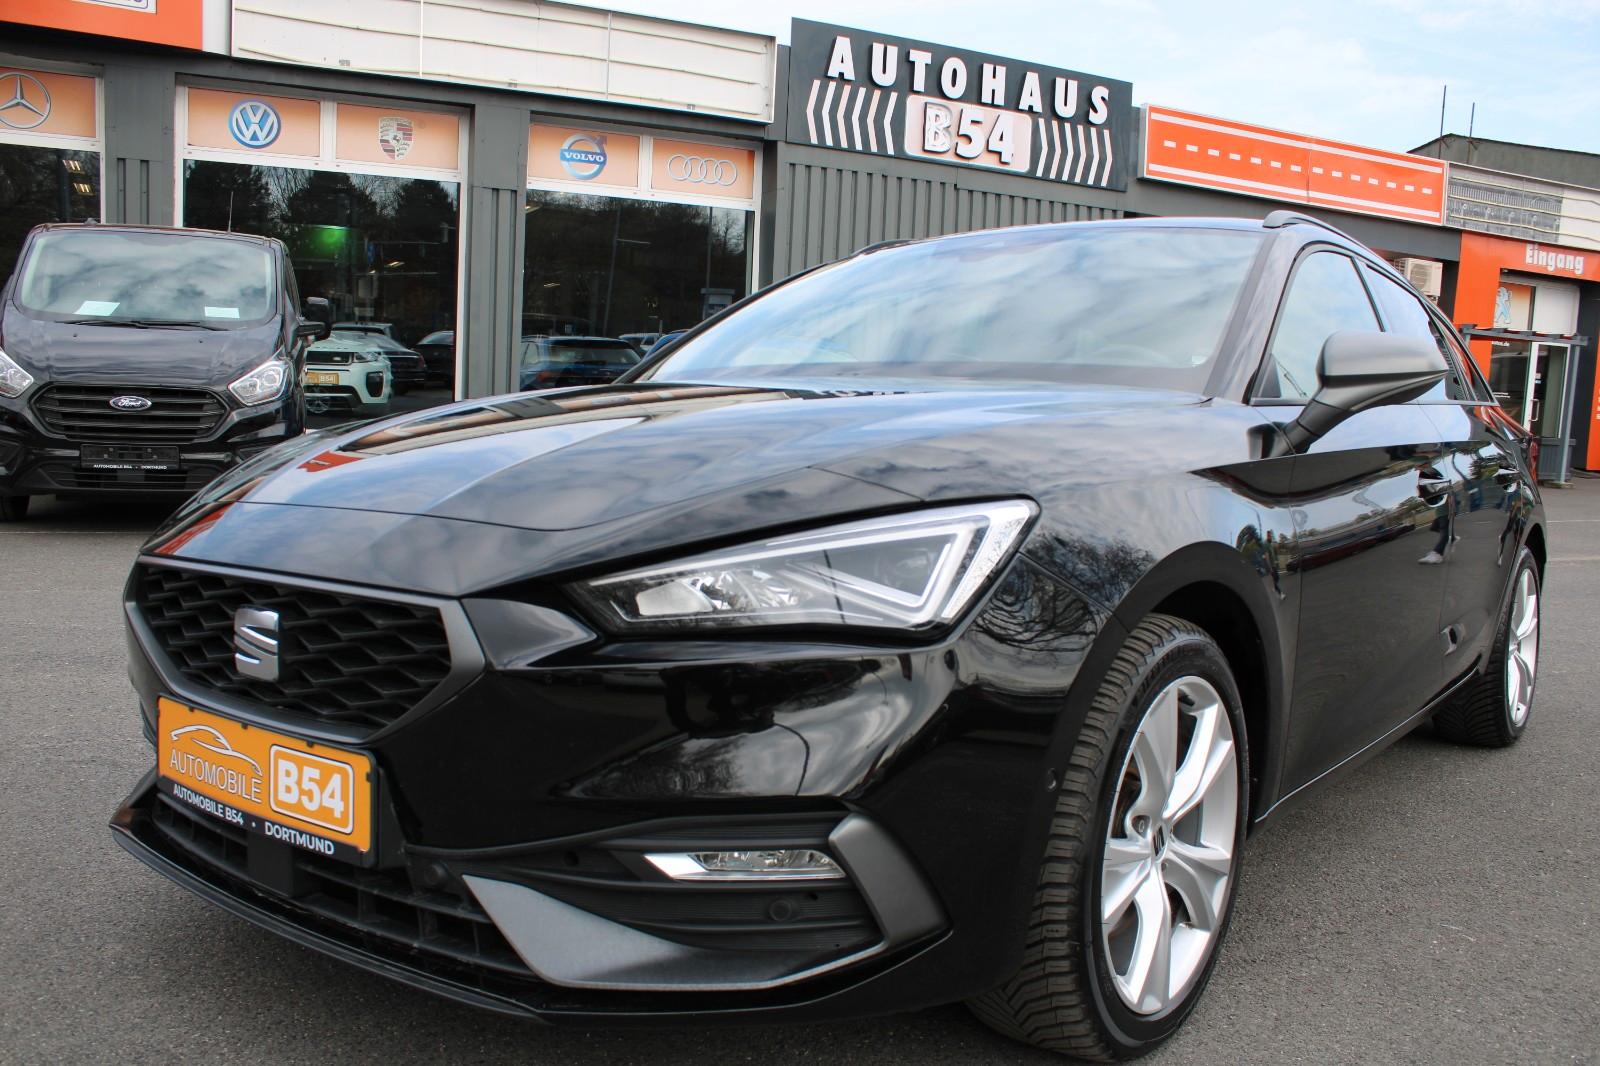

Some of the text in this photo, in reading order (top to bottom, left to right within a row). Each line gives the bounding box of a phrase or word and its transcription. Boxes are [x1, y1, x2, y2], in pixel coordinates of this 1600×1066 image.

[827, 35, 1110, 126] AUTOHAUS
[563, 151, 605, 163] VOLVO
[923, 101, 1014, 164] B54
[1525, 243, 1585, 275] Eingang
[118, 398, 143, 407] Ford
[169, 749, 345, 819] AUTOMOBILE B54
[172, 783, 335, 856] AUTOMOBILE B54 DORTMUND
